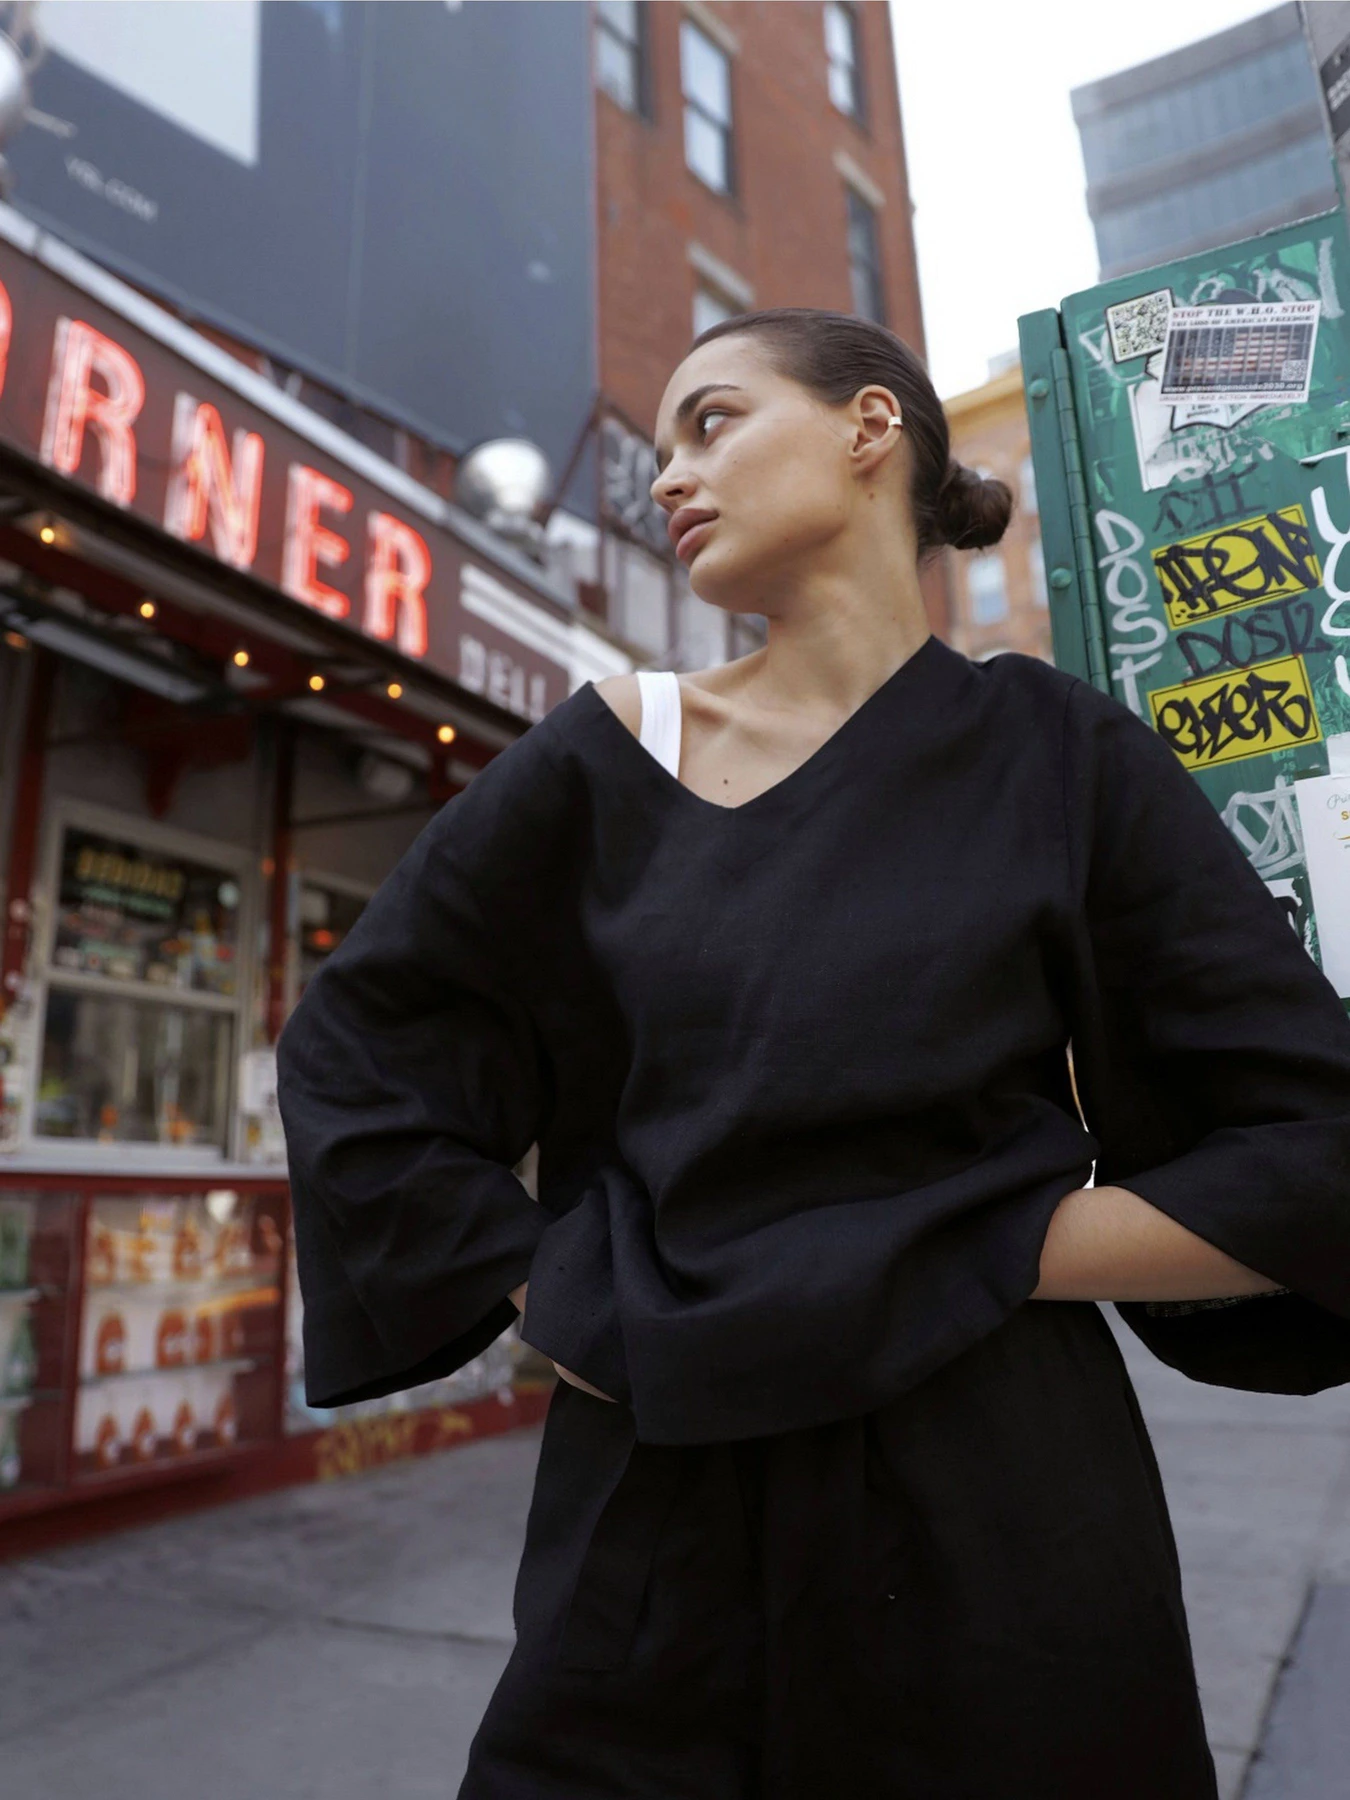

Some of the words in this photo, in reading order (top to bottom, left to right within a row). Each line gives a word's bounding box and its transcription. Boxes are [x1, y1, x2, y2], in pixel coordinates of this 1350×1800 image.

[1172, 309, 1203, 318] STOP
[1208, 307, 1231, 317] THE
[1281, 303, 1315, 313] STOP
